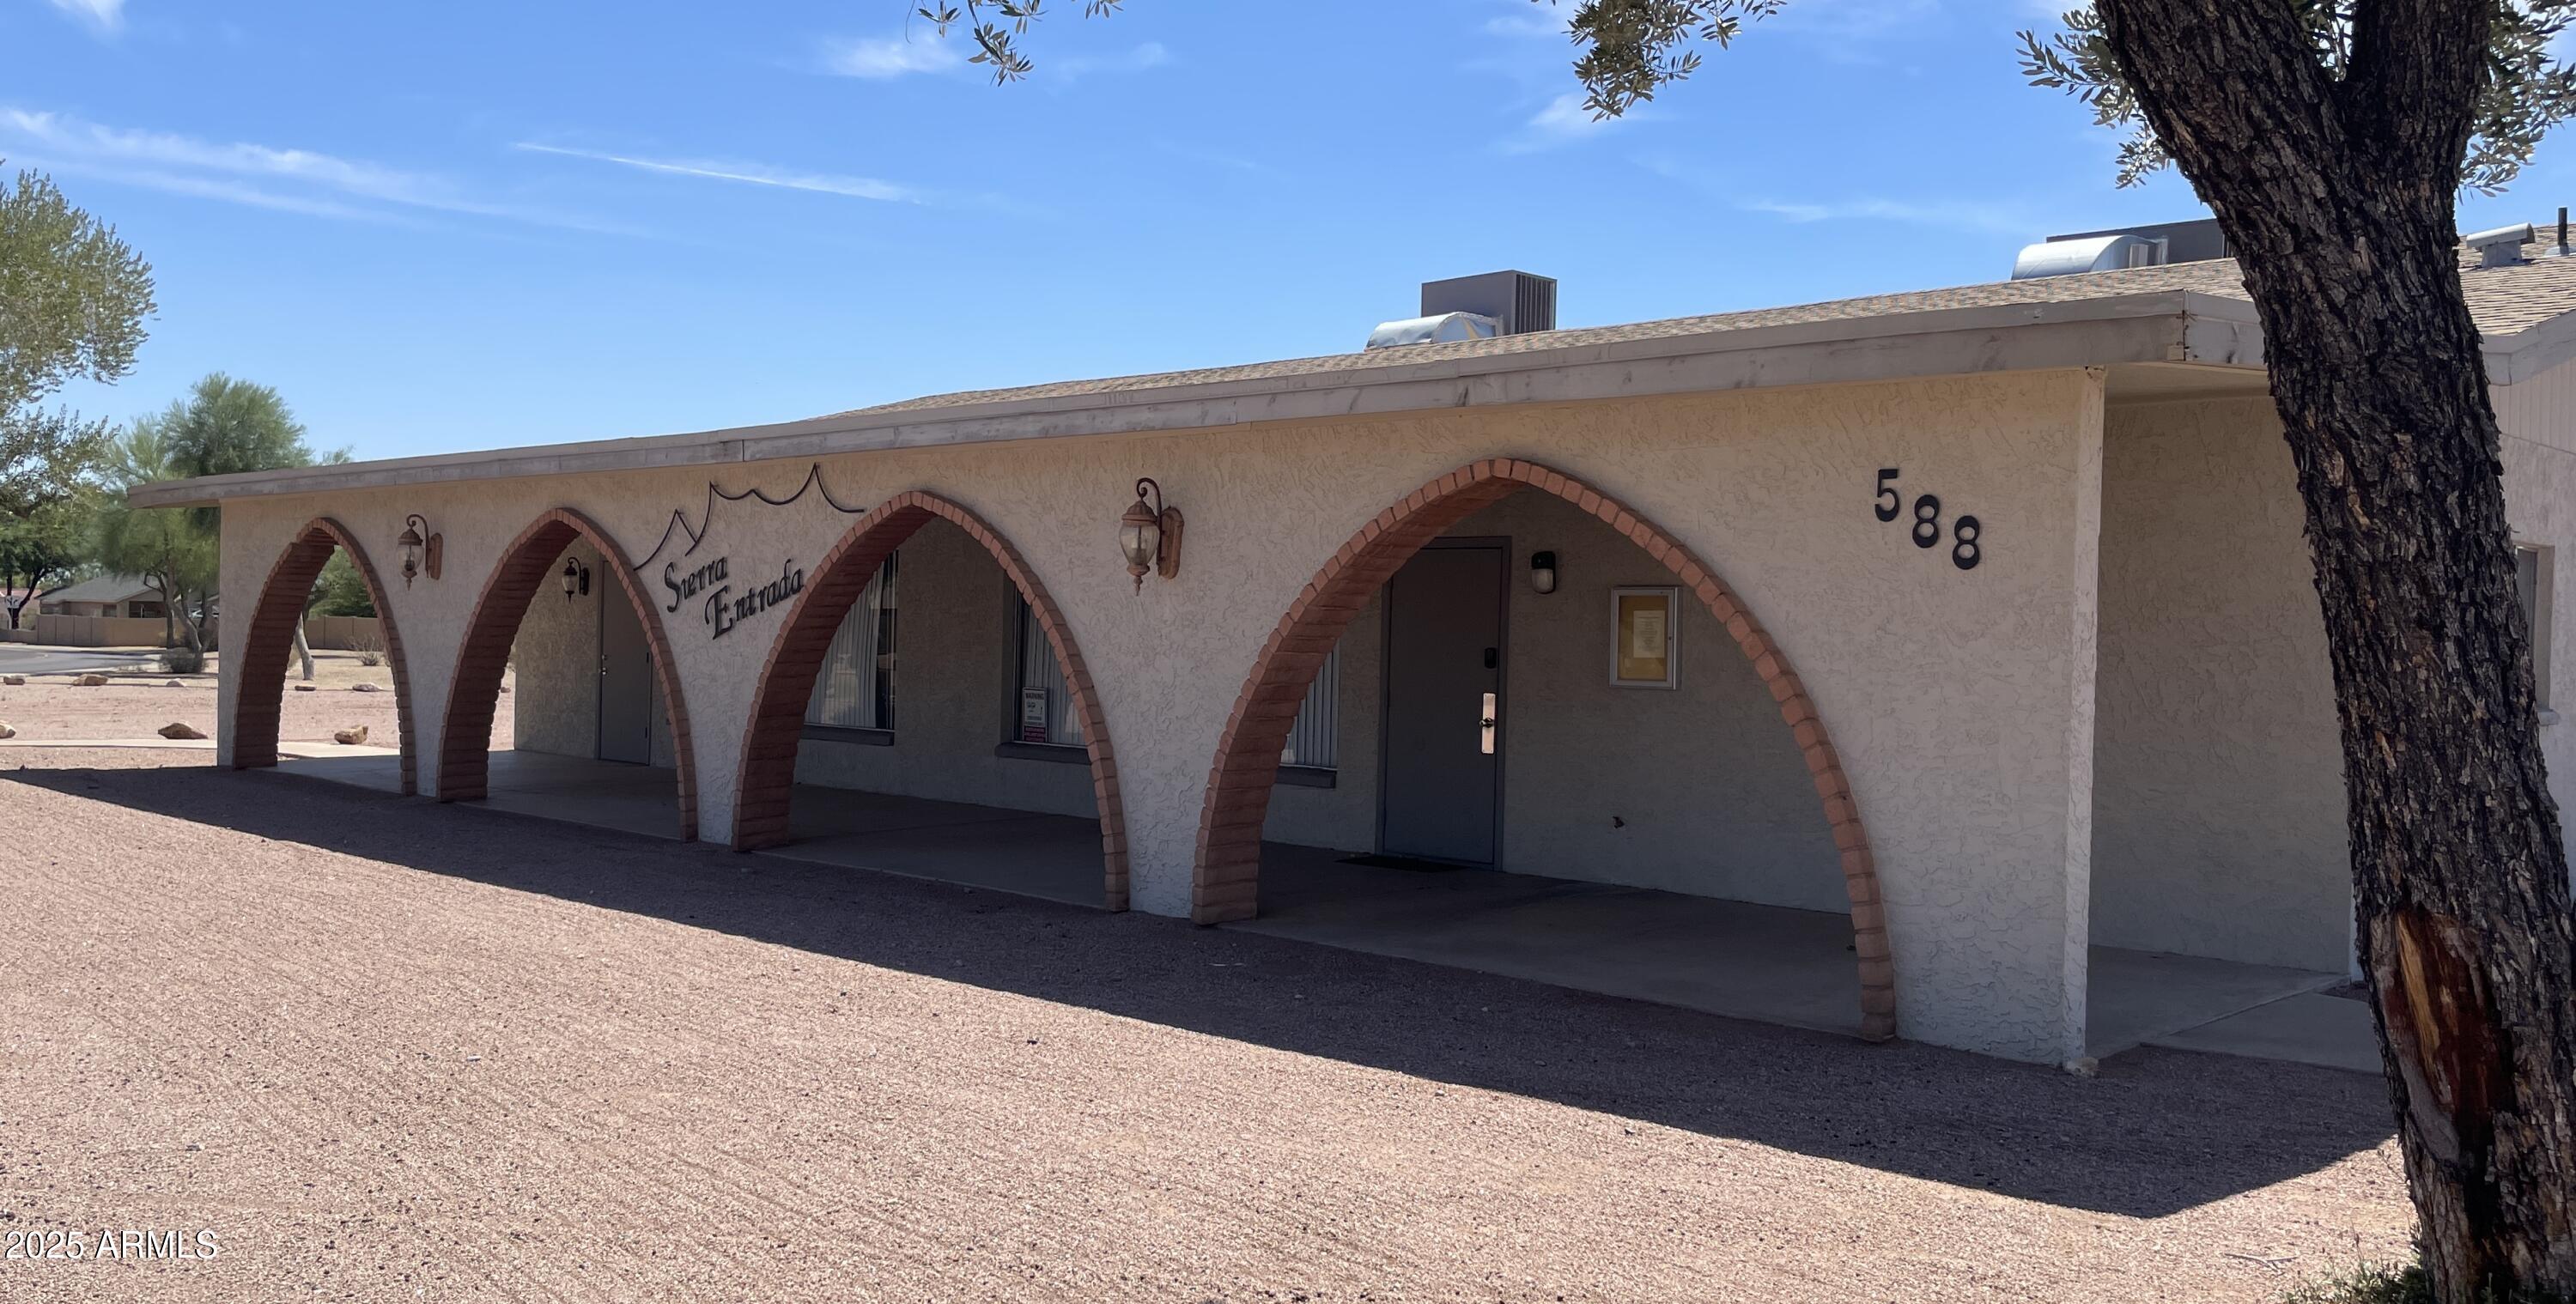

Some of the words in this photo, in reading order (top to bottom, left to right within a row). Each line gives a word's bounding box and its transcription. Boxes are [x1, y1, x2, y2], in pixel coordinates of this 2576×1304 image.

[1875, 469, 1980, 570] 588
[664, 556, 728, 613] Sierra
[704, 559, 805, 640] Entrada
